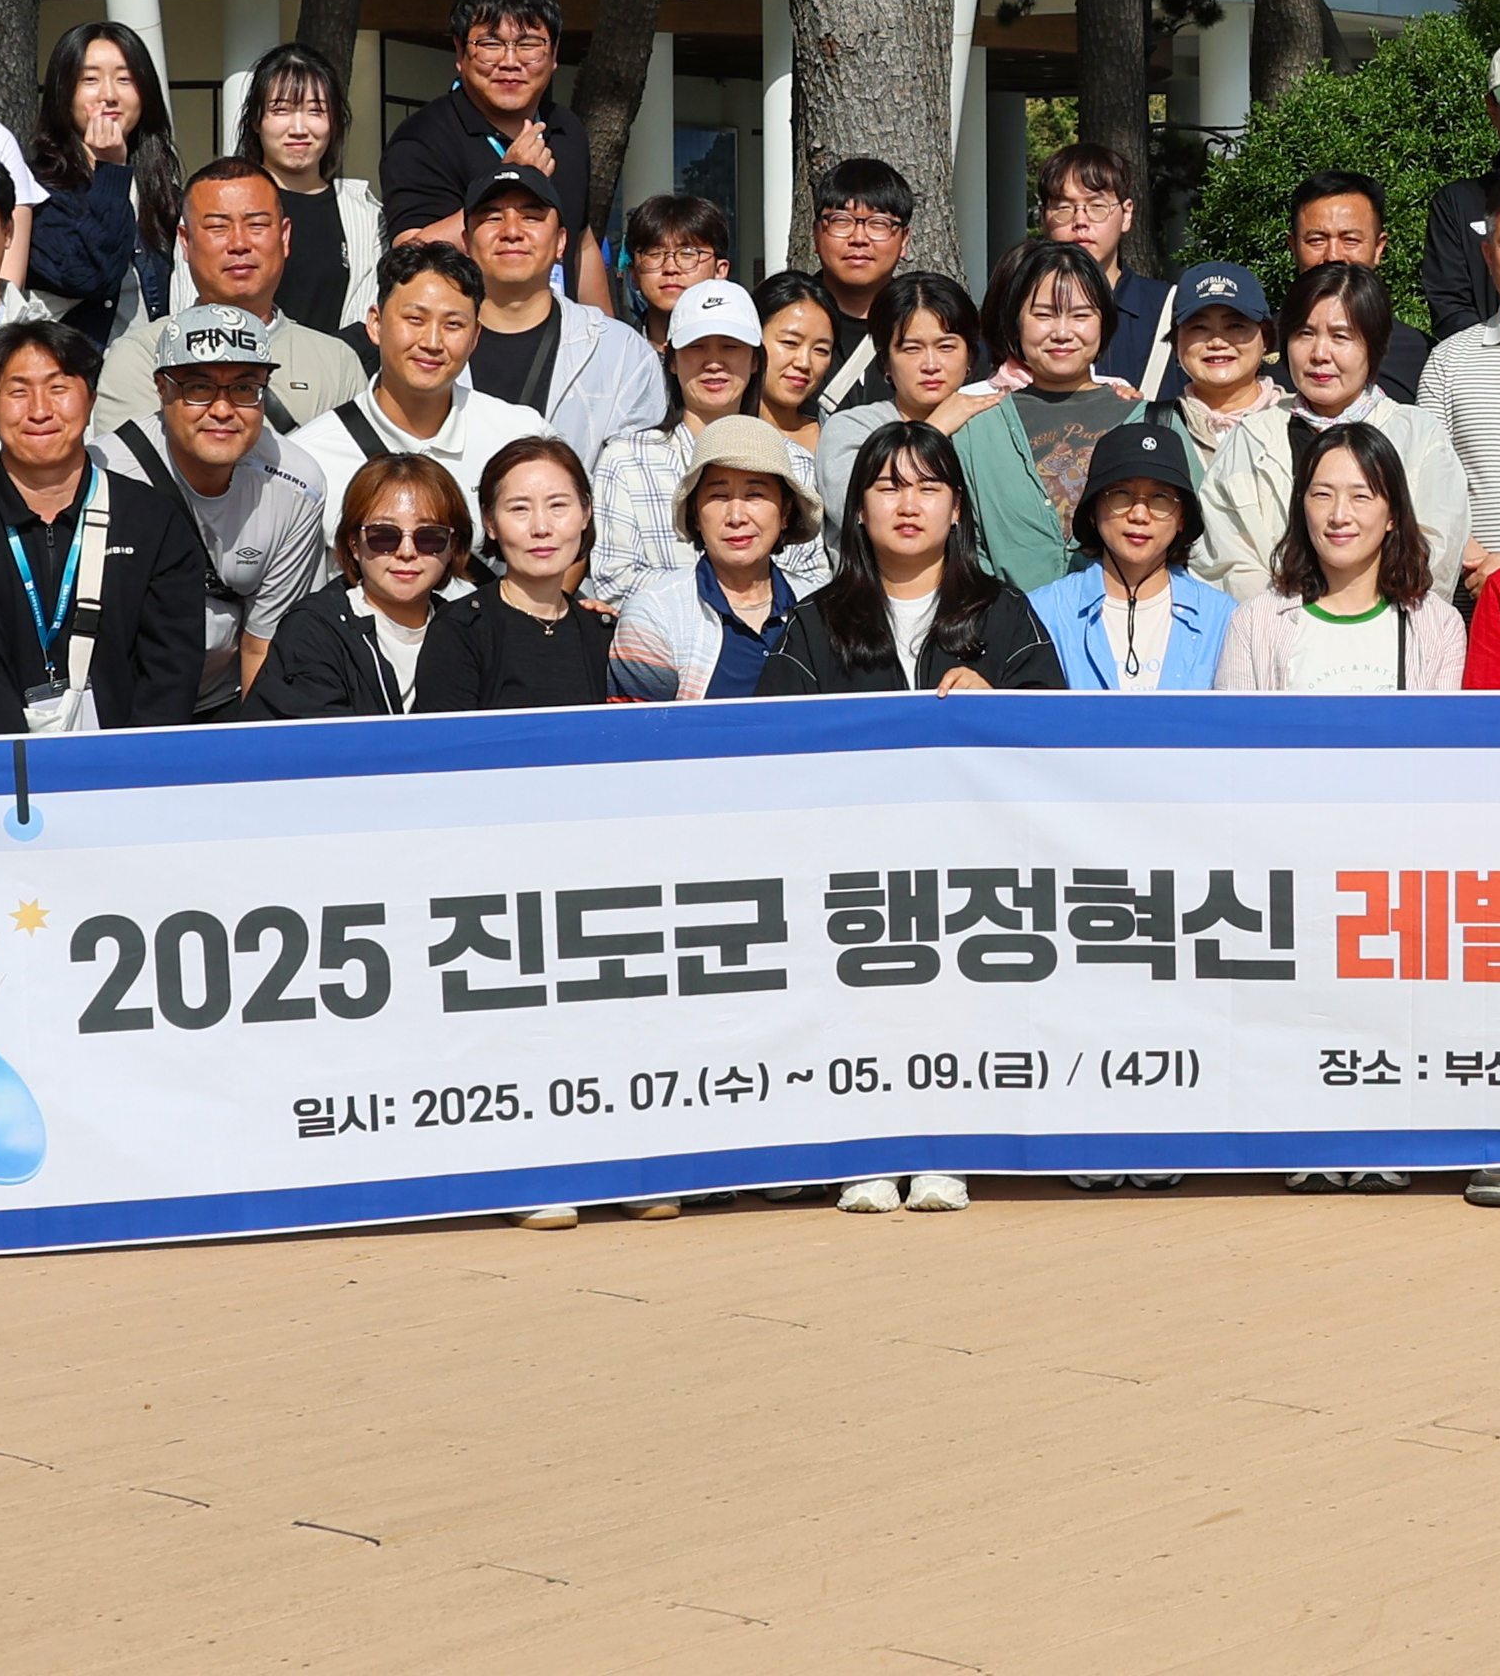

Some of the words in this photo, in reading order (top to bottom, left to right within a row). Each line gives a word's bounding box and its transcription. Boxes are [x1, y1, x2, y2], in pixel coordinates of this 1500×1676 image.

[186, 328, 258, 353] PING
[264, 465, 307, 489] UMBRO
[70, 903, 392, 1035] 2025
[429, 878, 788, 1013] 진도군
[824, 868, 1296, 987] 행정혁신
[1319, 1049, 1401, 1086] 장소
[292, 1094, 396, 1139] 일시:
[412, 1084, 533, 1128] 2025.
[549, 1077, 614, 1117] 05.
[630, 1062, 770, 1111] 07.(수)
[828, 1056, 892, 1095] 05.
[907, 1050, 1049, 1091] 09.(금)
[1100, 1049, 1200, 1090] (4기)
